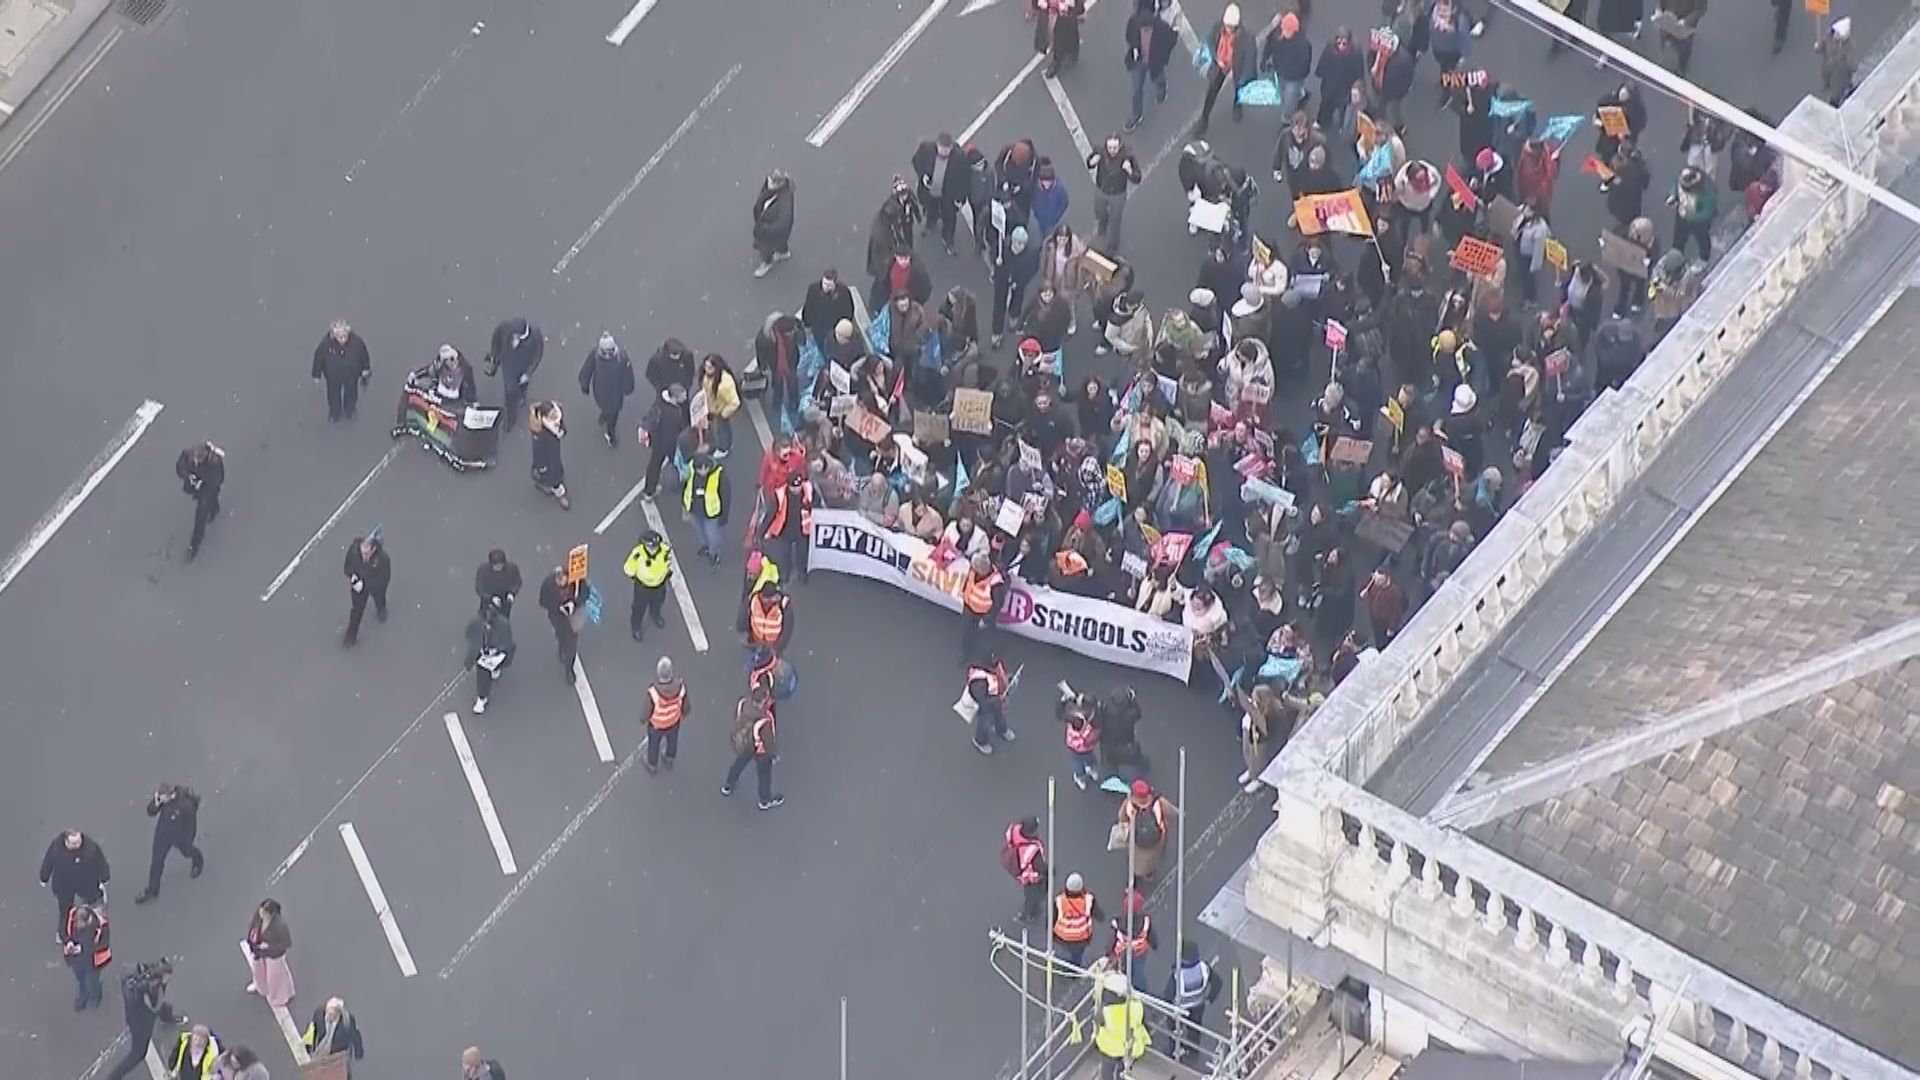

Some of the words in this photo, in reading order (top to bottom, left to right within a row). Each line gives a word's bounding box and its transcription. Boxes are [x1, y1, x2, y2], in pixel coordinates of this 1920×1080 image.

[1441, 71, 1466, 88] PAY
[1467, 70, 1487, 88] UP
[816, 525, 863, 551] PAY
[1032, 603, 1148, 653] SCHOOLS
